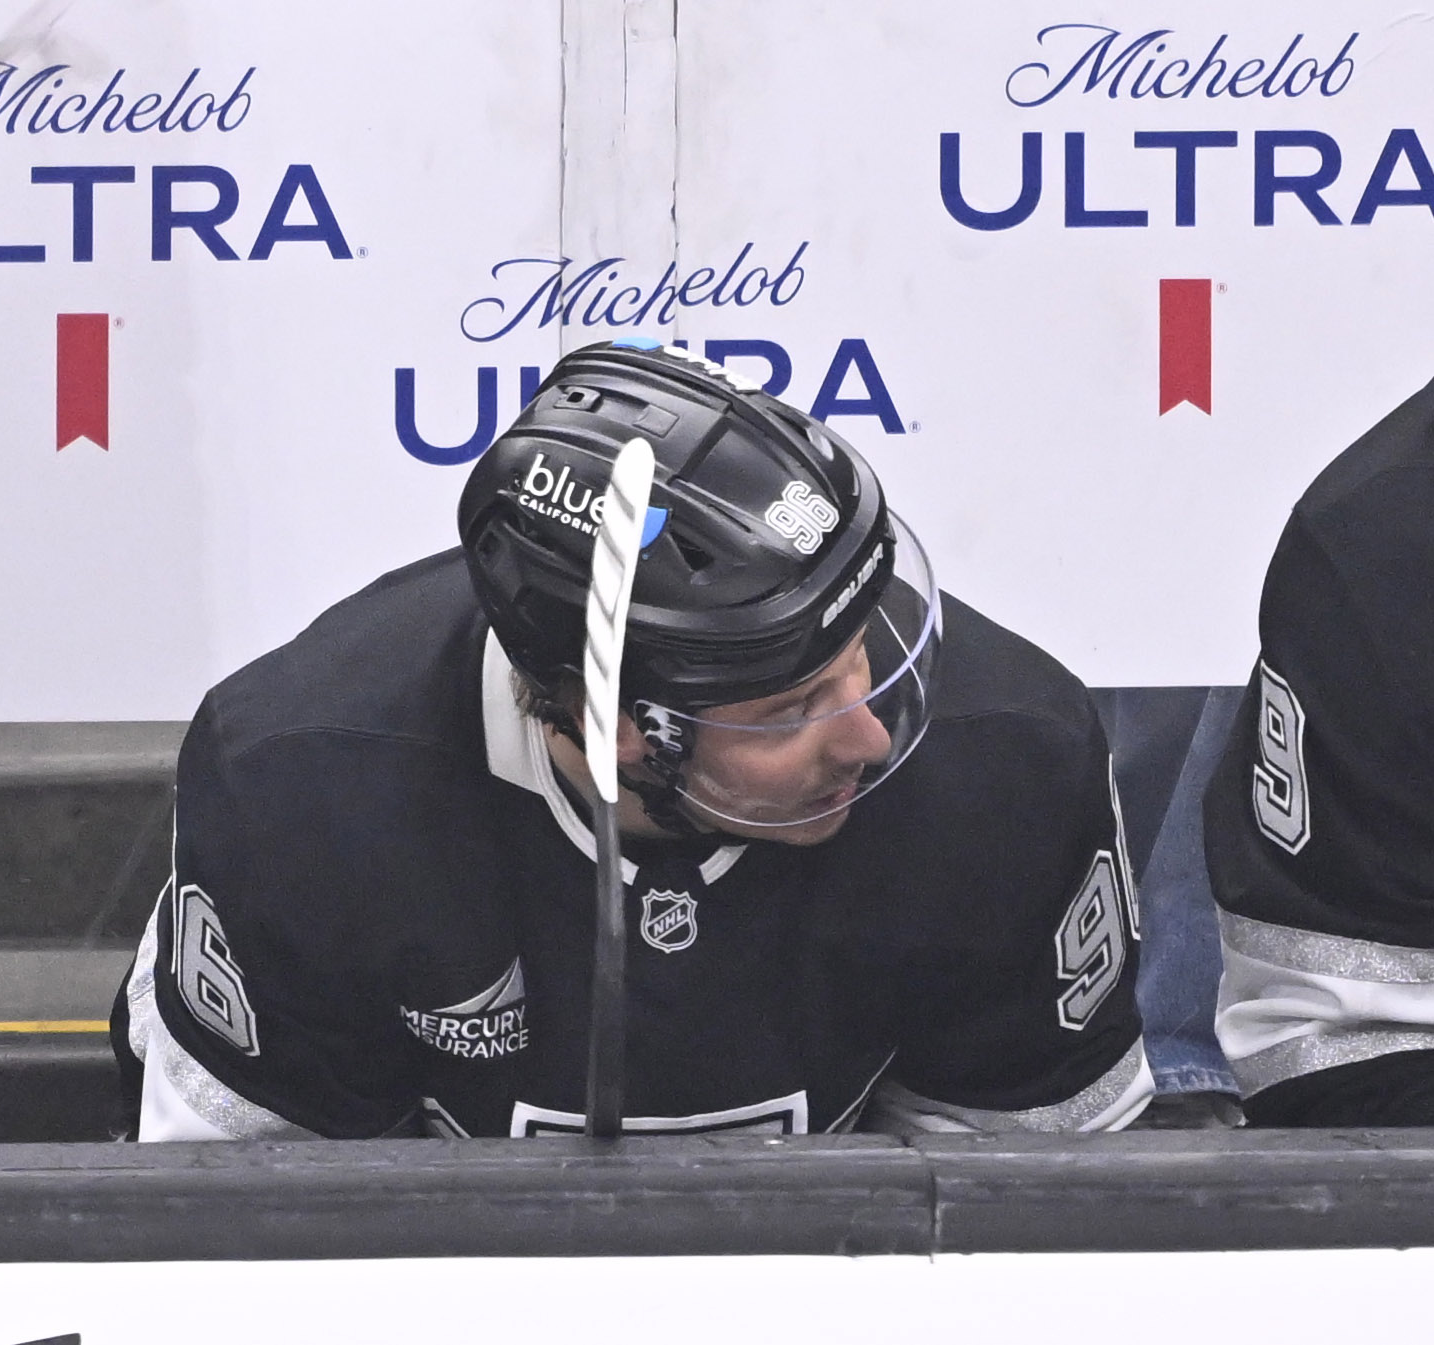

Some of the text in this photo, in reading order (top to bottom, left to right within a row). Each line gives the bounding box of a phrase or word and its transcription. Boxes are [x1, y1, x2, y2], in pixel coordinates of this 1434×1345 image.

[1005, 24, 1360, 108] Michelob
[938, 128, 1434, 232] ULTRA
[460, 241, 811, 343] Michelob
[519, 494, 599, 537] CALIFORNI
[765, 480, 839, 554] 96
[653, 908, 686, 937] NHL
[399, 1004, 526, 1041] MERCURY
[406, 1021, 530, 1059] NSURANCE
